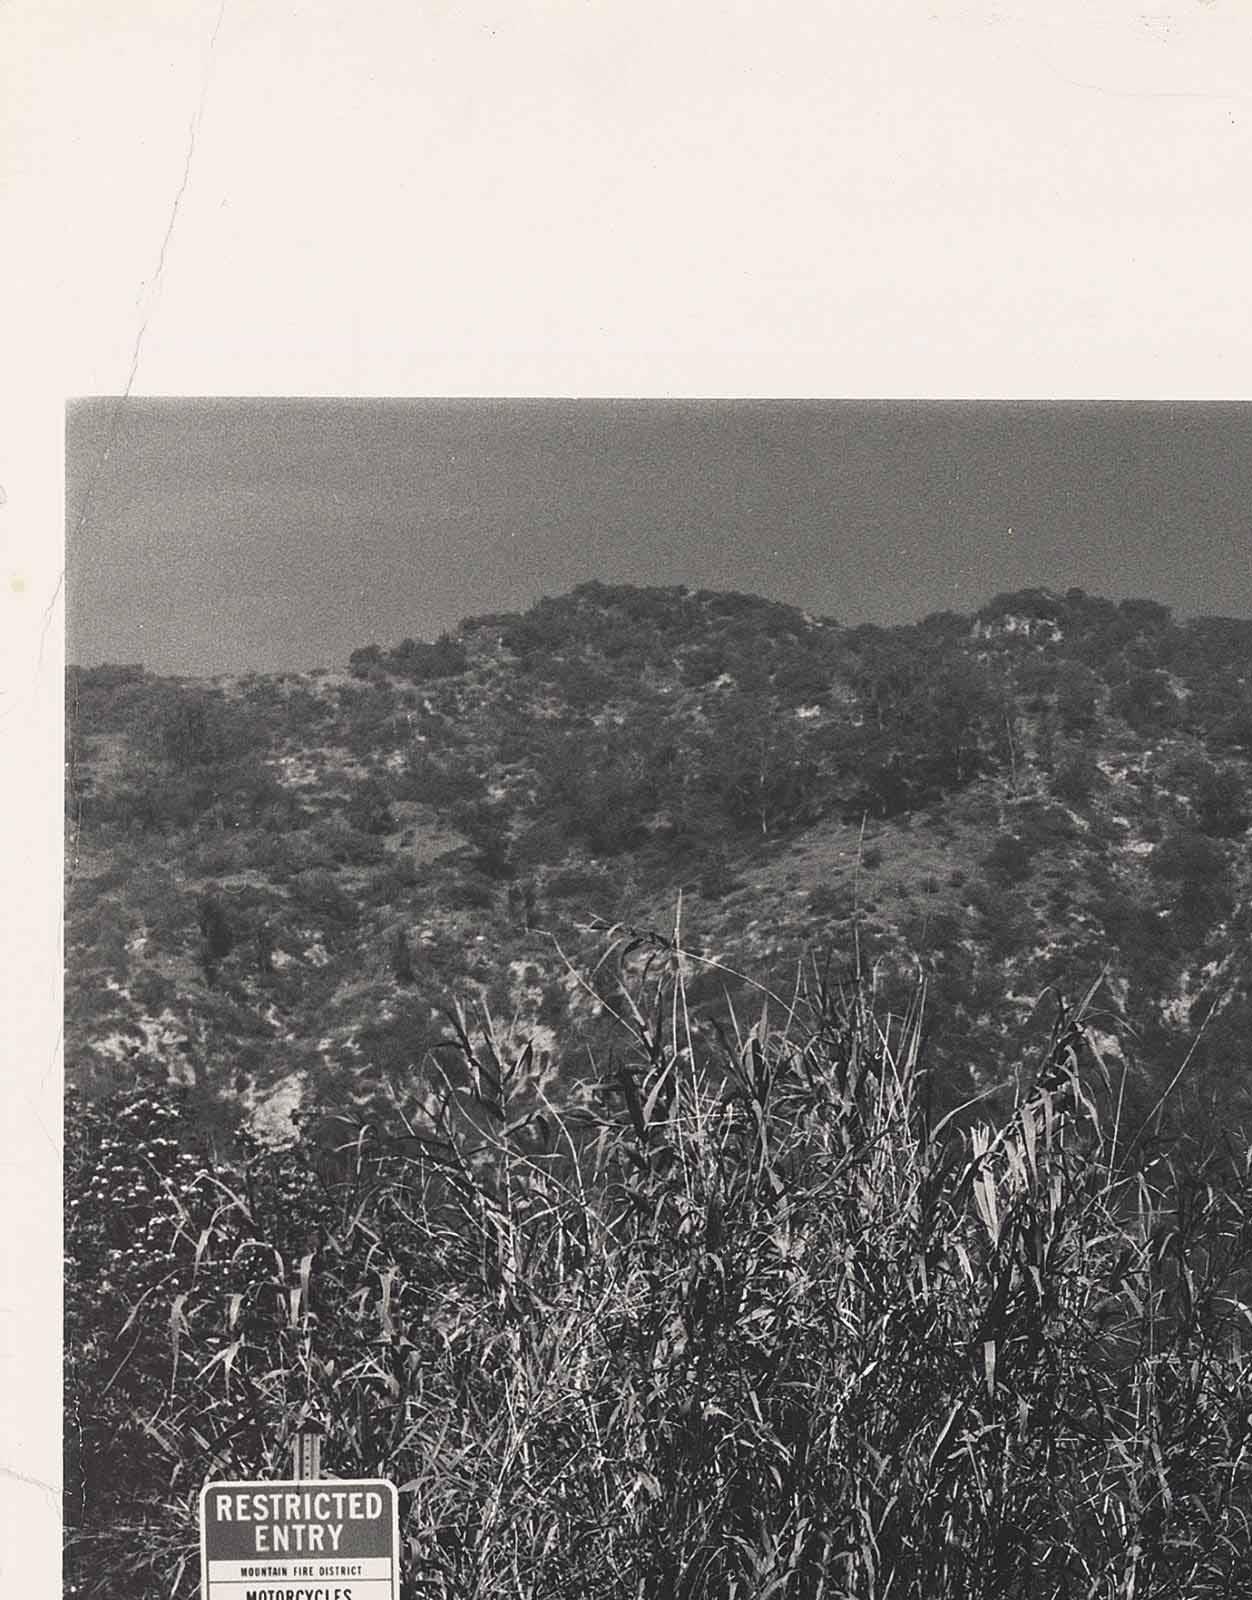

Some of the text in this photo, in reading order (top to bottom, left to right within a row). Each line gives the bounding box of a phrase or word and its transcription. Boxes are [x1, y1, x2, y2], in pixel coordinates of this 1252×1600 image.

[216, 1492, 383, 1521] RESTRICTED
[255, 1523, 344, 1552] ENTRY
[240, 1565, 362, 1577] MOUNTAIN FIRE DISTRICT
